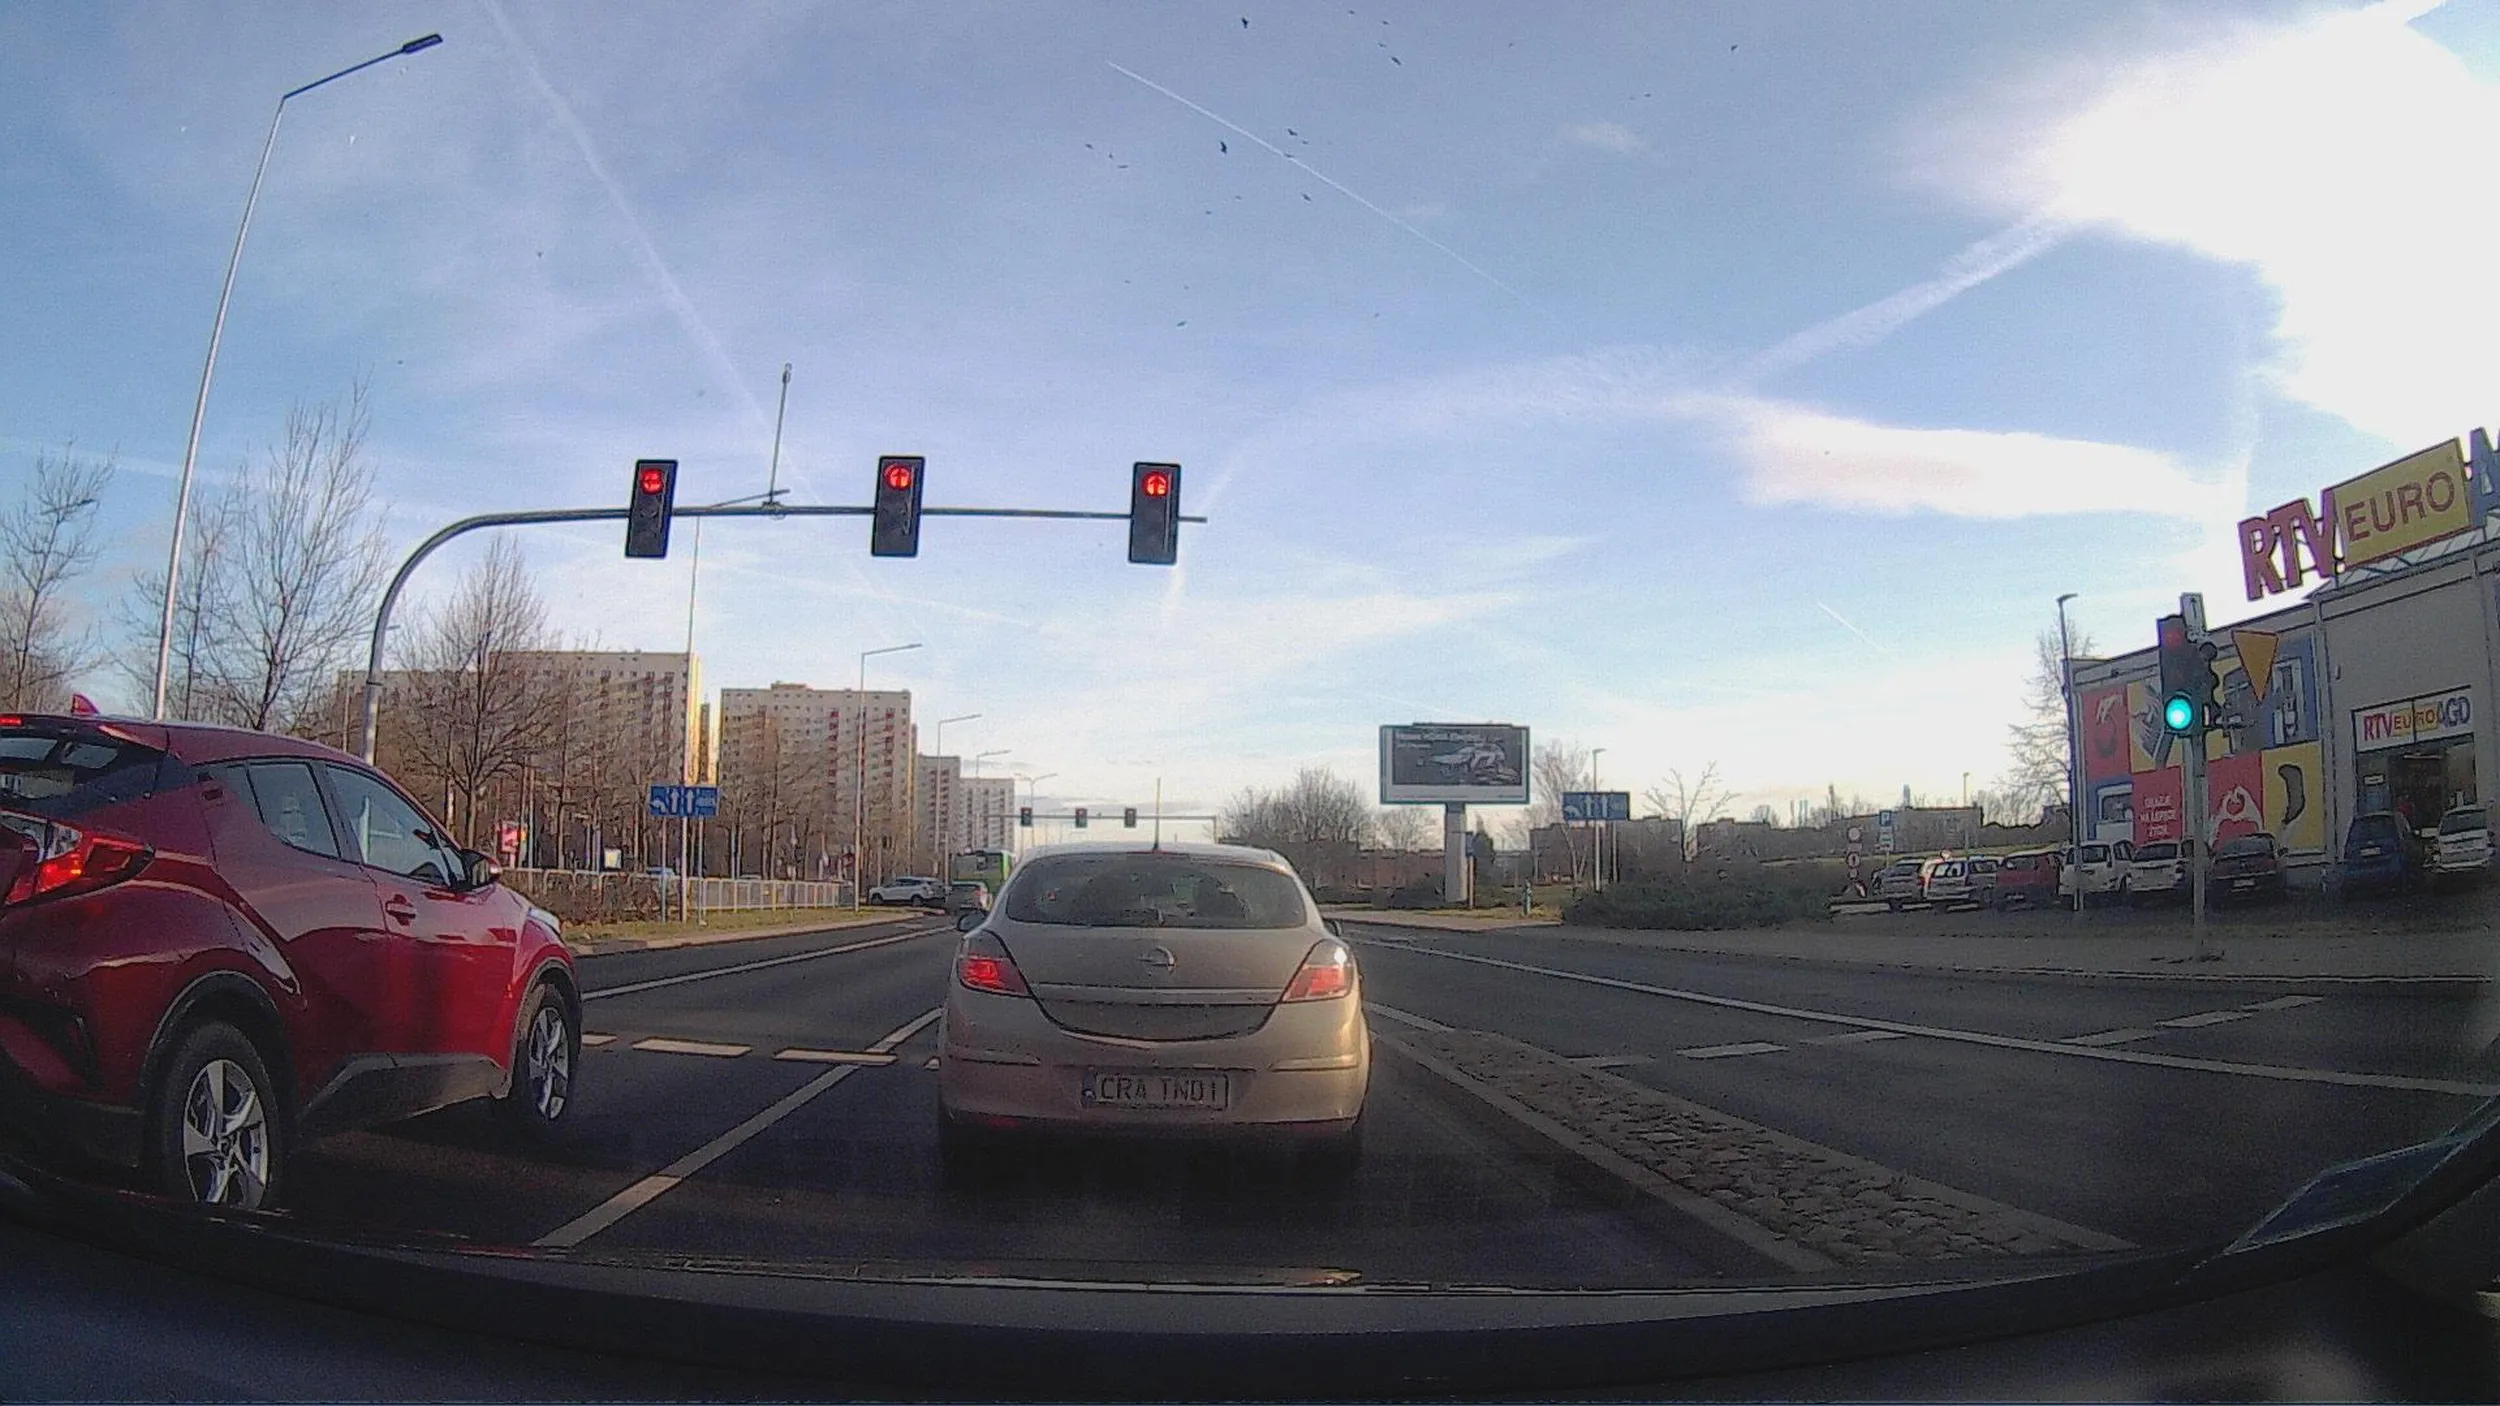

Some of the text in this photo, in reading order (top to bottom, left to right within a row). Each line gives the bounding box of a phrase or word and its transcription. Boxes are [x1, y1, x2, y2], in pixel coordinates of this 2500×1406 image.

[2237, 487, 2339, 602] RTV
[2344, 471, 2456, 542] EURO
[2363, 711, 2392, 741] RTV
[2437, 696, 2471, 728] AGD
